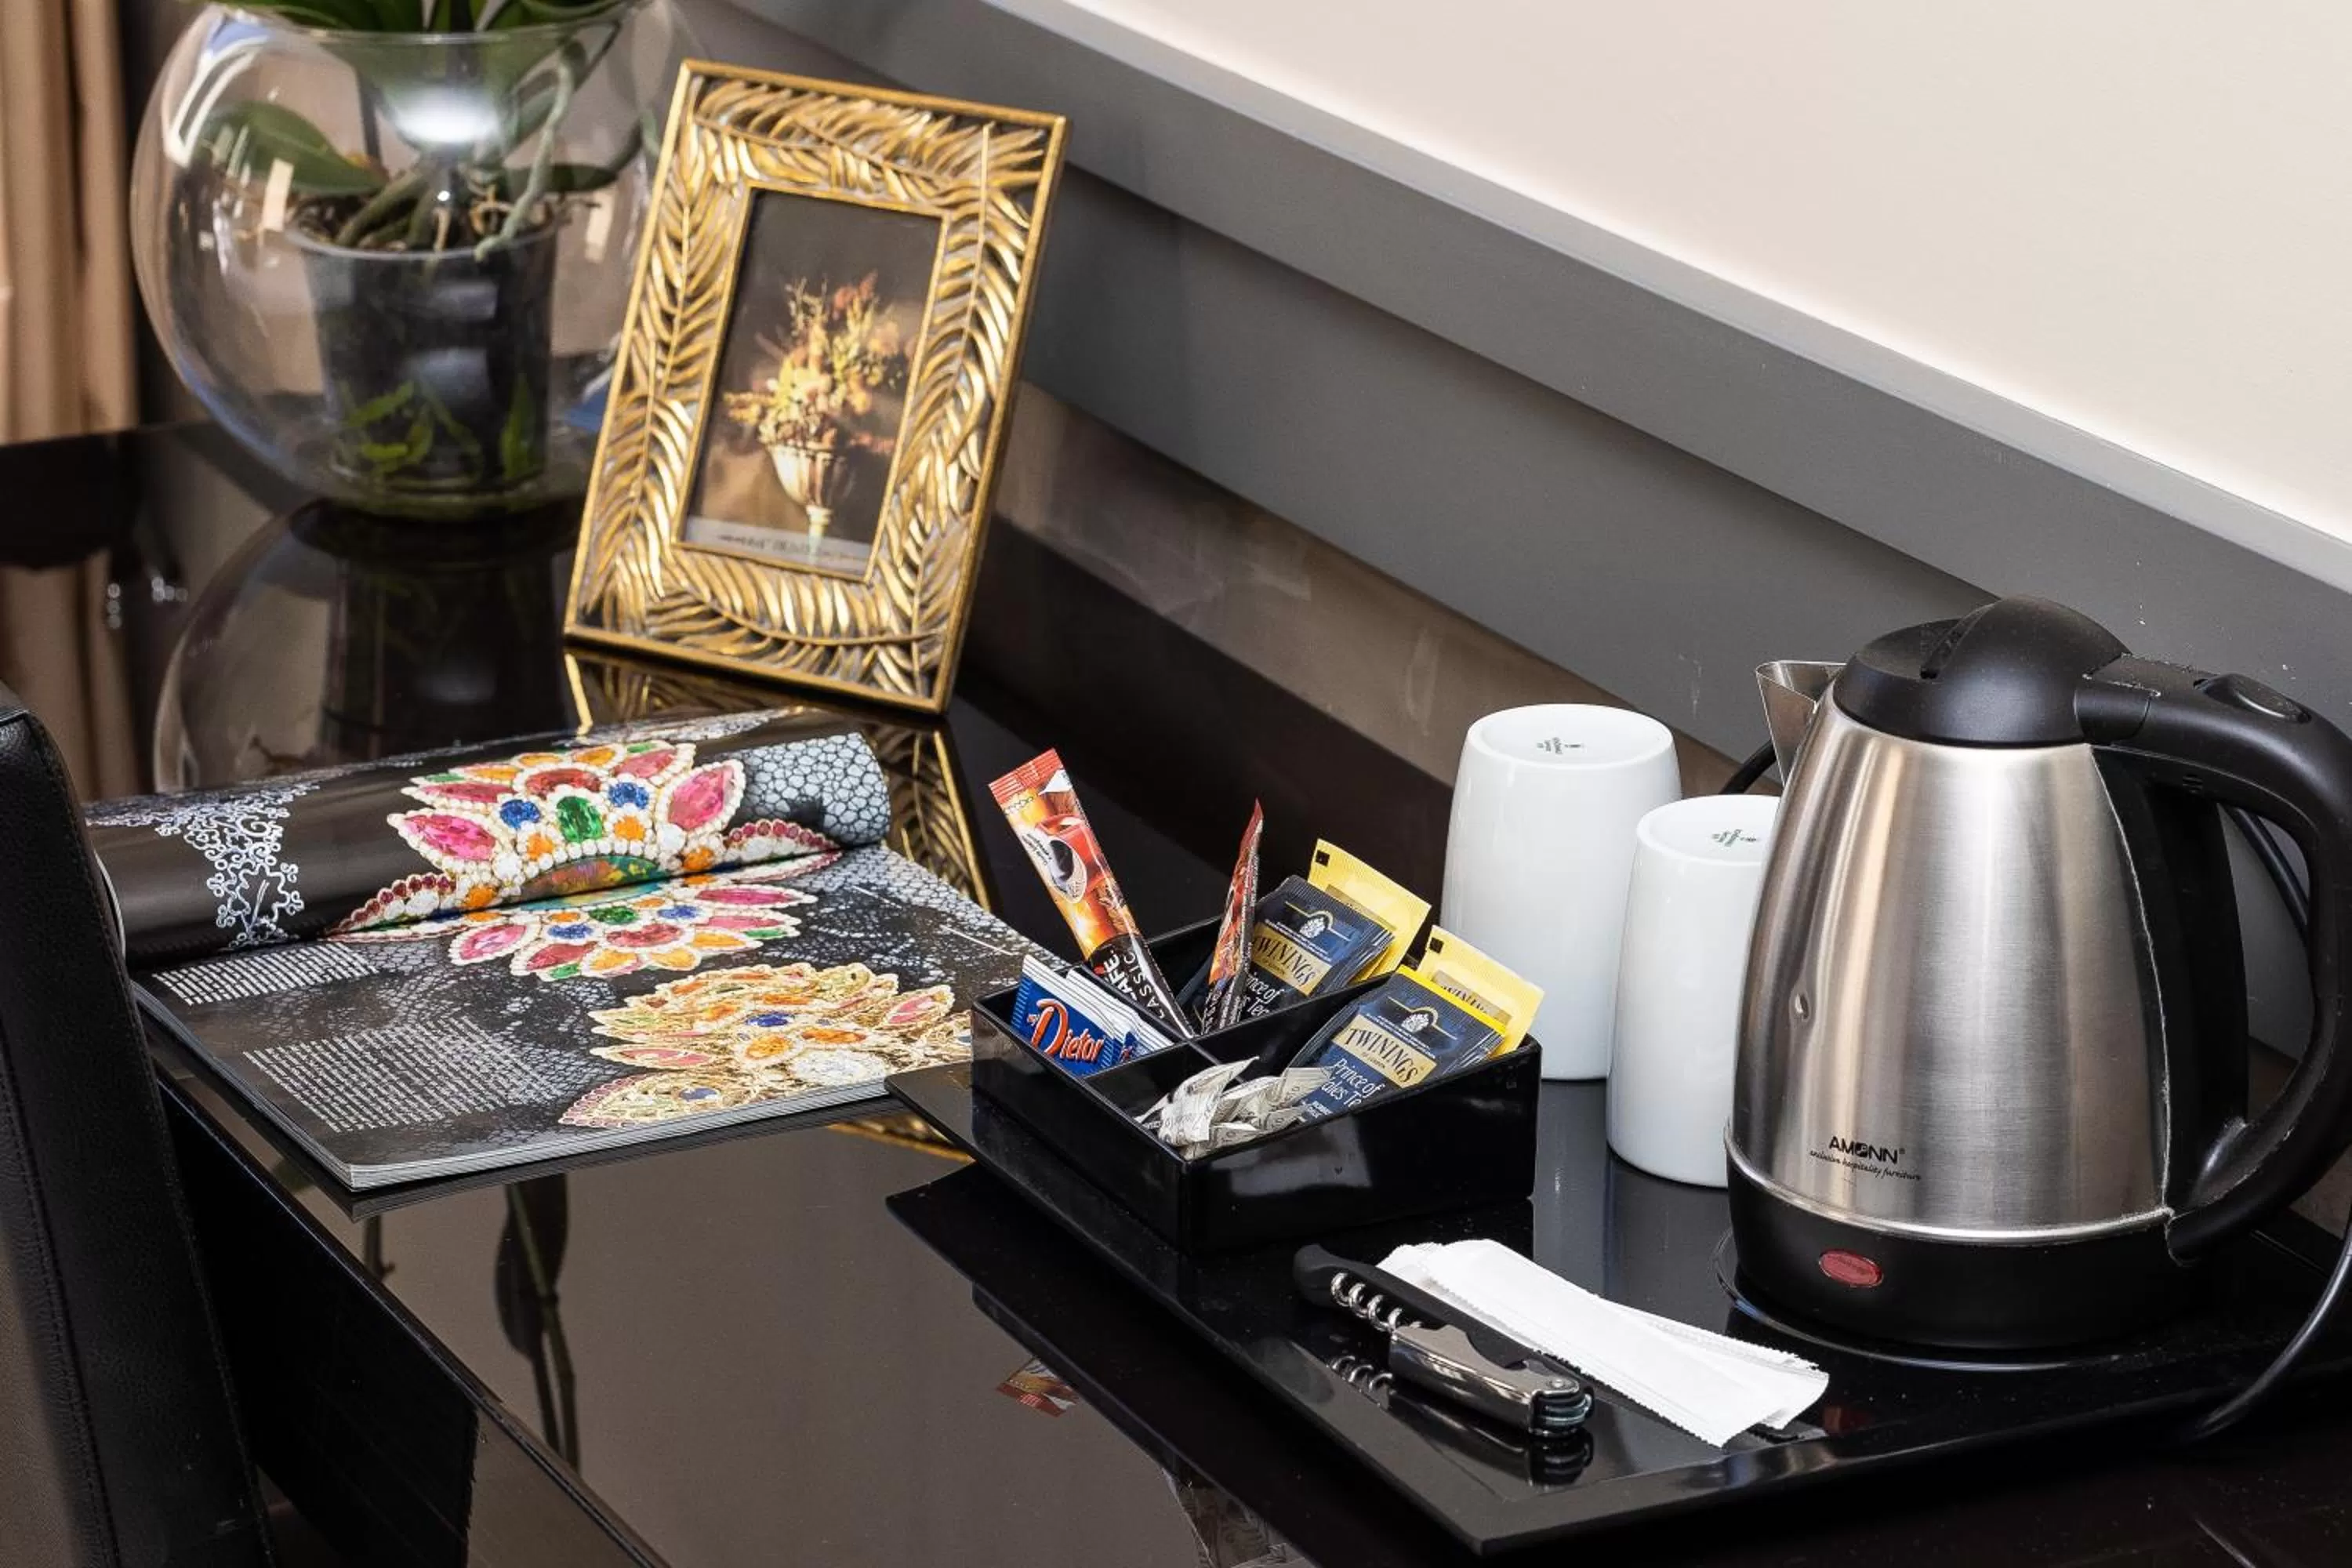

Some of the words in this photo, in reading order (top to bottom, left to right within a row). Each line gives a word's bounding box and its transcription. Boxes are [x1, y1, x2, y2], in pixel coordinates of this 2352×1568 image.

[1254, 936, 1316, 986] WININGS
[1030, 998, 1105, 1062] Dietor
[1345, 1028, 1418, 1083] TWININGS
[1334, 1058, 1368, 1089] Prince
[1362, 1083, 1386, 1099] of
